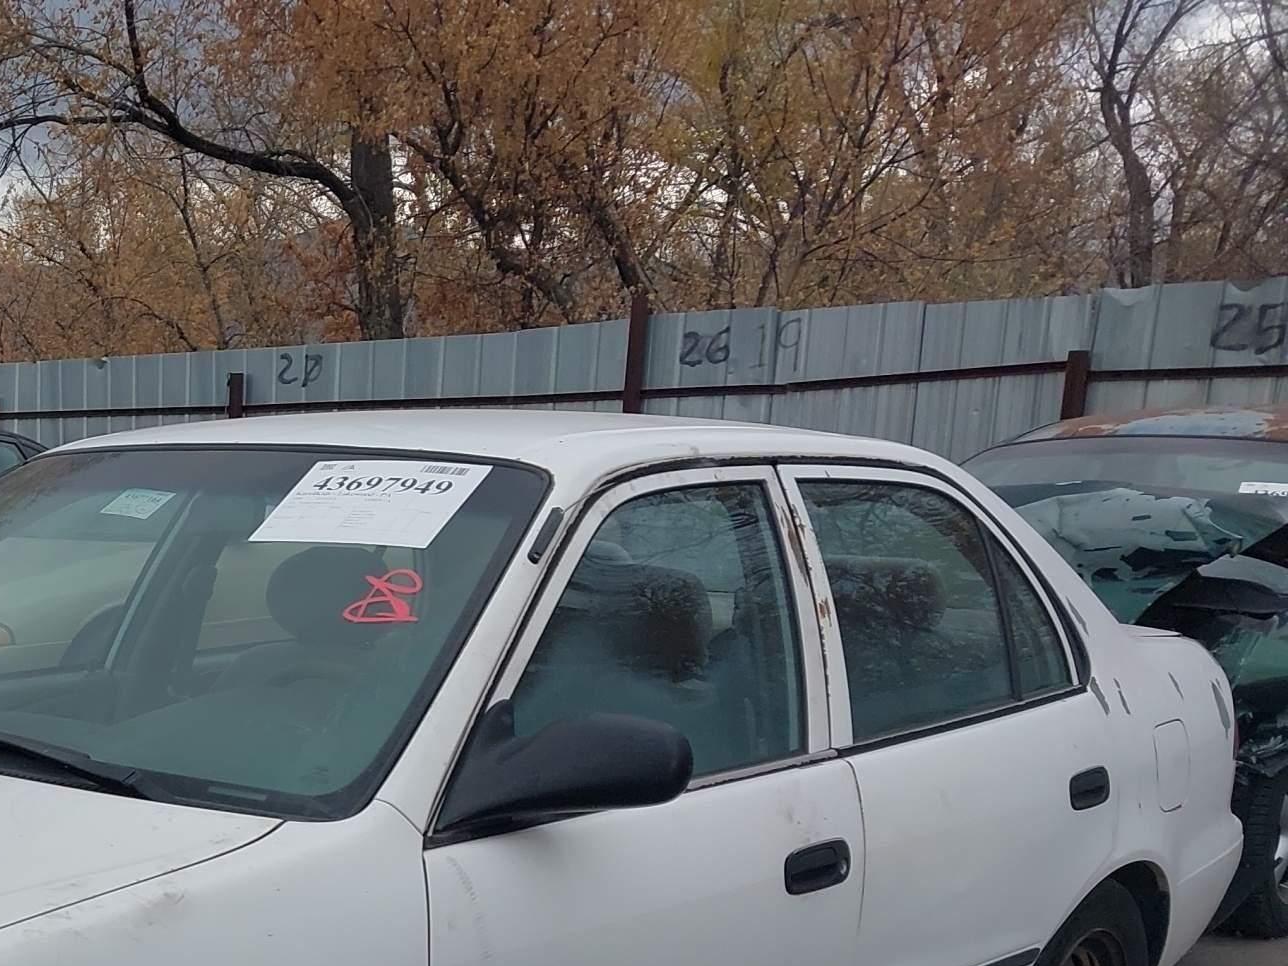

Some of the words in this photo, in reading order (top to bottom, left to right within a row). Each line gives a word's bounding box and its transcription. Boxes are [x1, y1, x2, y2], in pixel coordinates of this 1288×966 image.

[679, 325, 731, 368] 26
[1210, 302, 1288, 355] 25
[312, 475, 454, 496] 43697949
